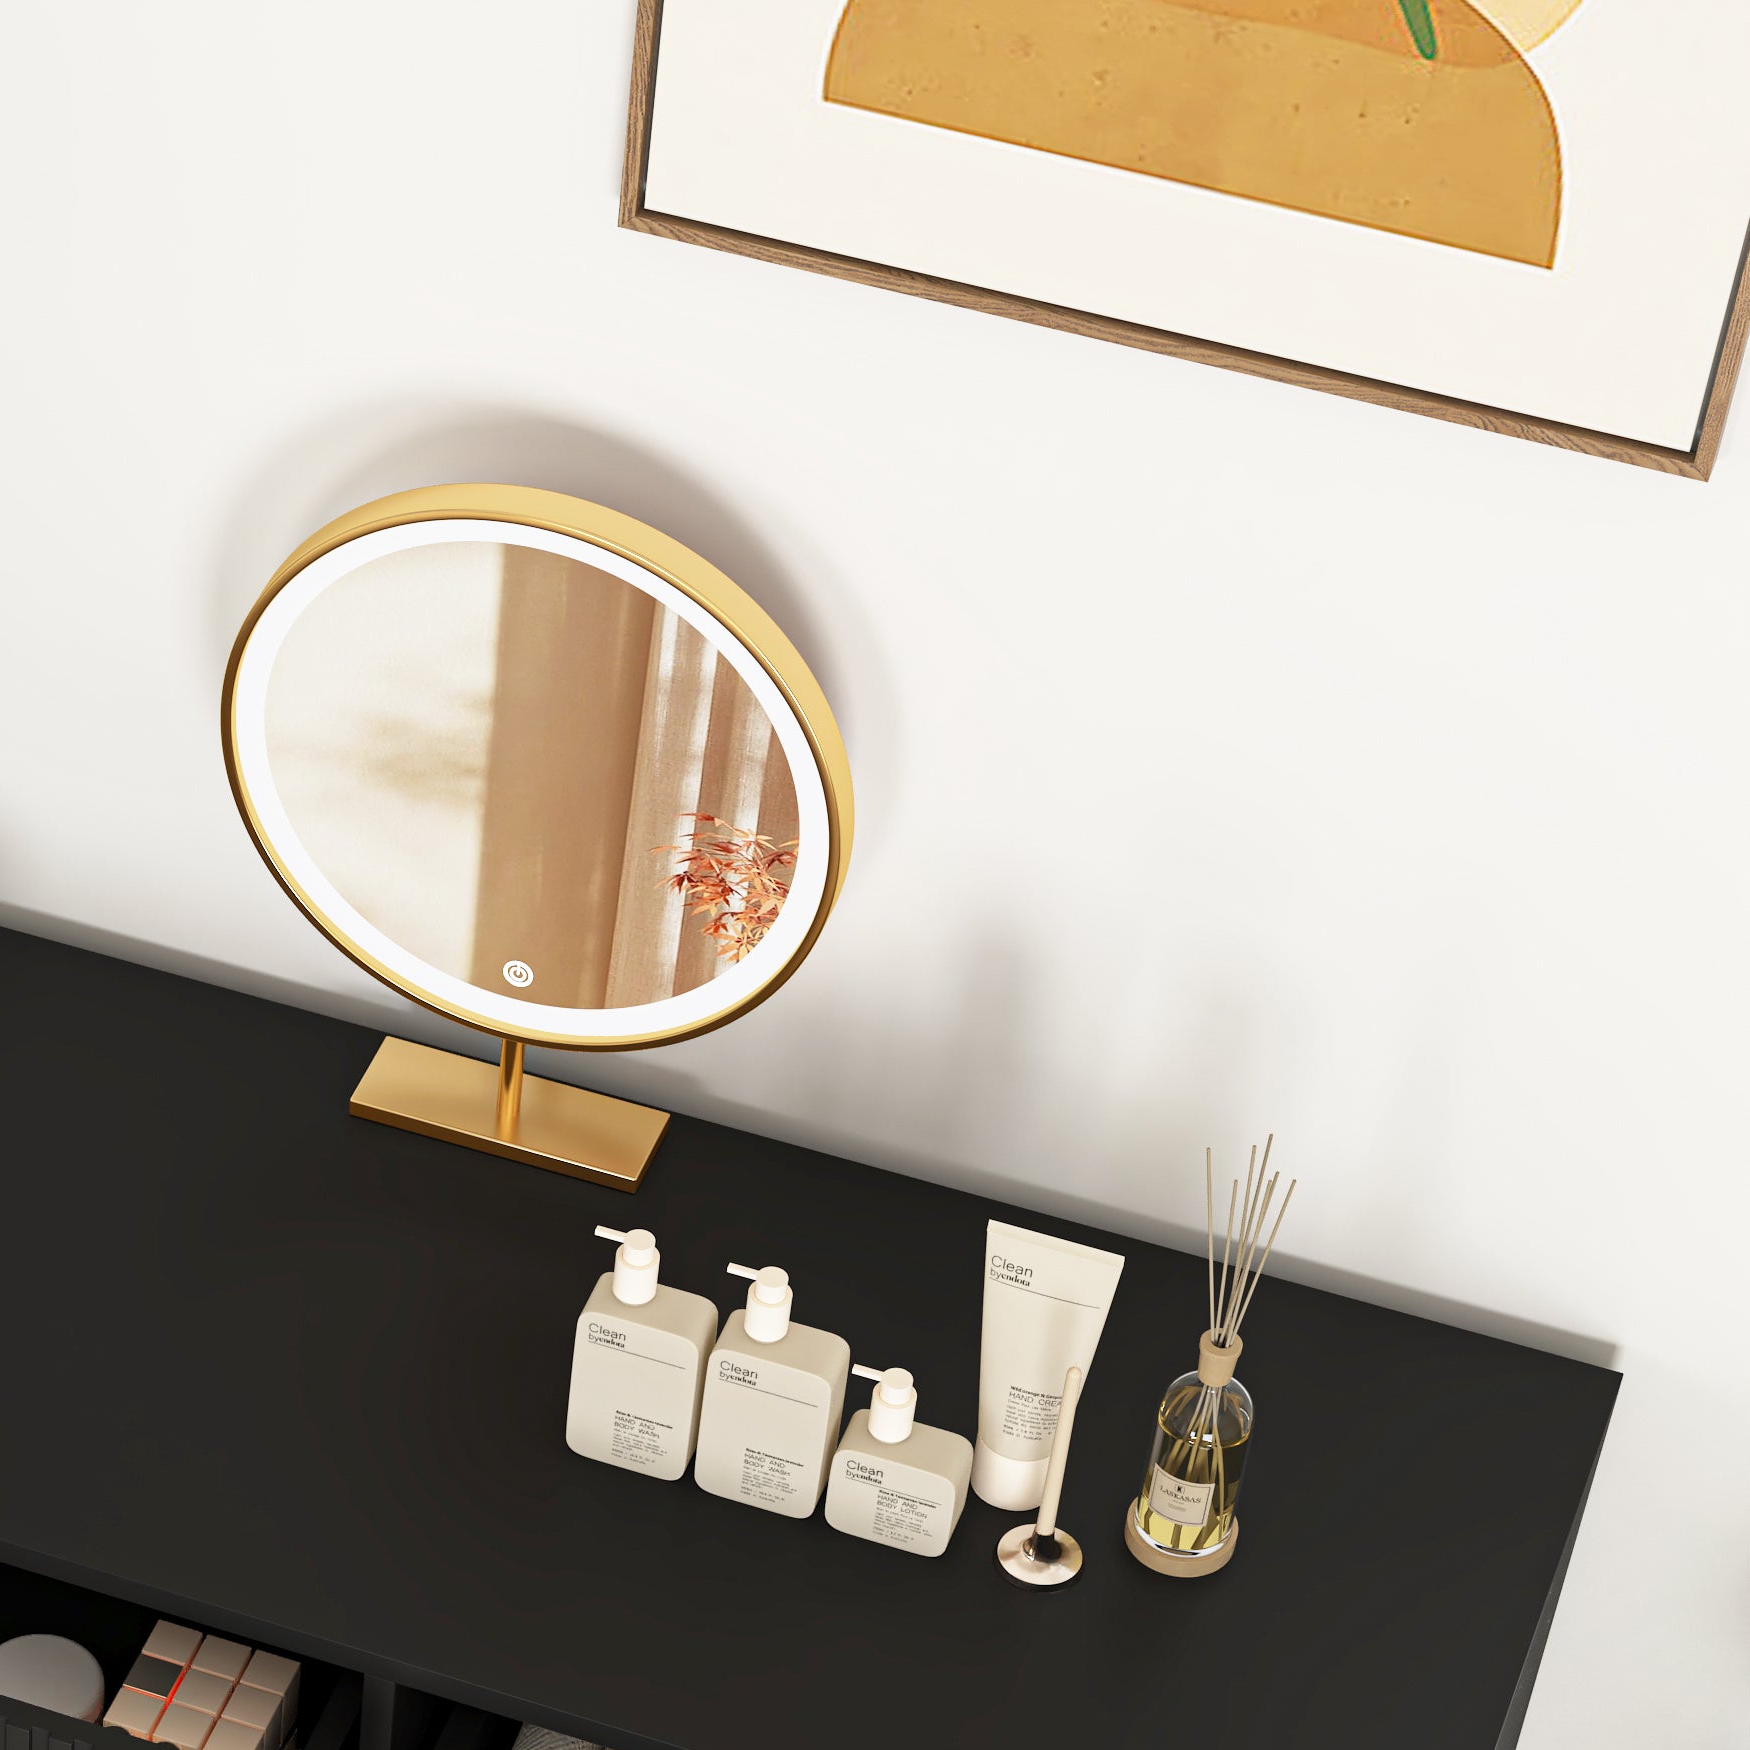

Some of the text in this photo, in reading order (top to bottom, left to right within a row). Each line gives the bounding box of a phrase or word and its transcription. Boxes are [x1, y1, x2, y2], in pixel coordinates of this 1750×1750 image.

[991, 1255, 1033, 1278] Clean
[588, 1322, 626, 1341] Clean
[720, 1360, 758, 1379] Clean
[1038, 1398, 1062, 1407] CREA
[846, 1459, 884, 1478] Clean
[1160, 1485, 1202, 1503] LASKASAS
